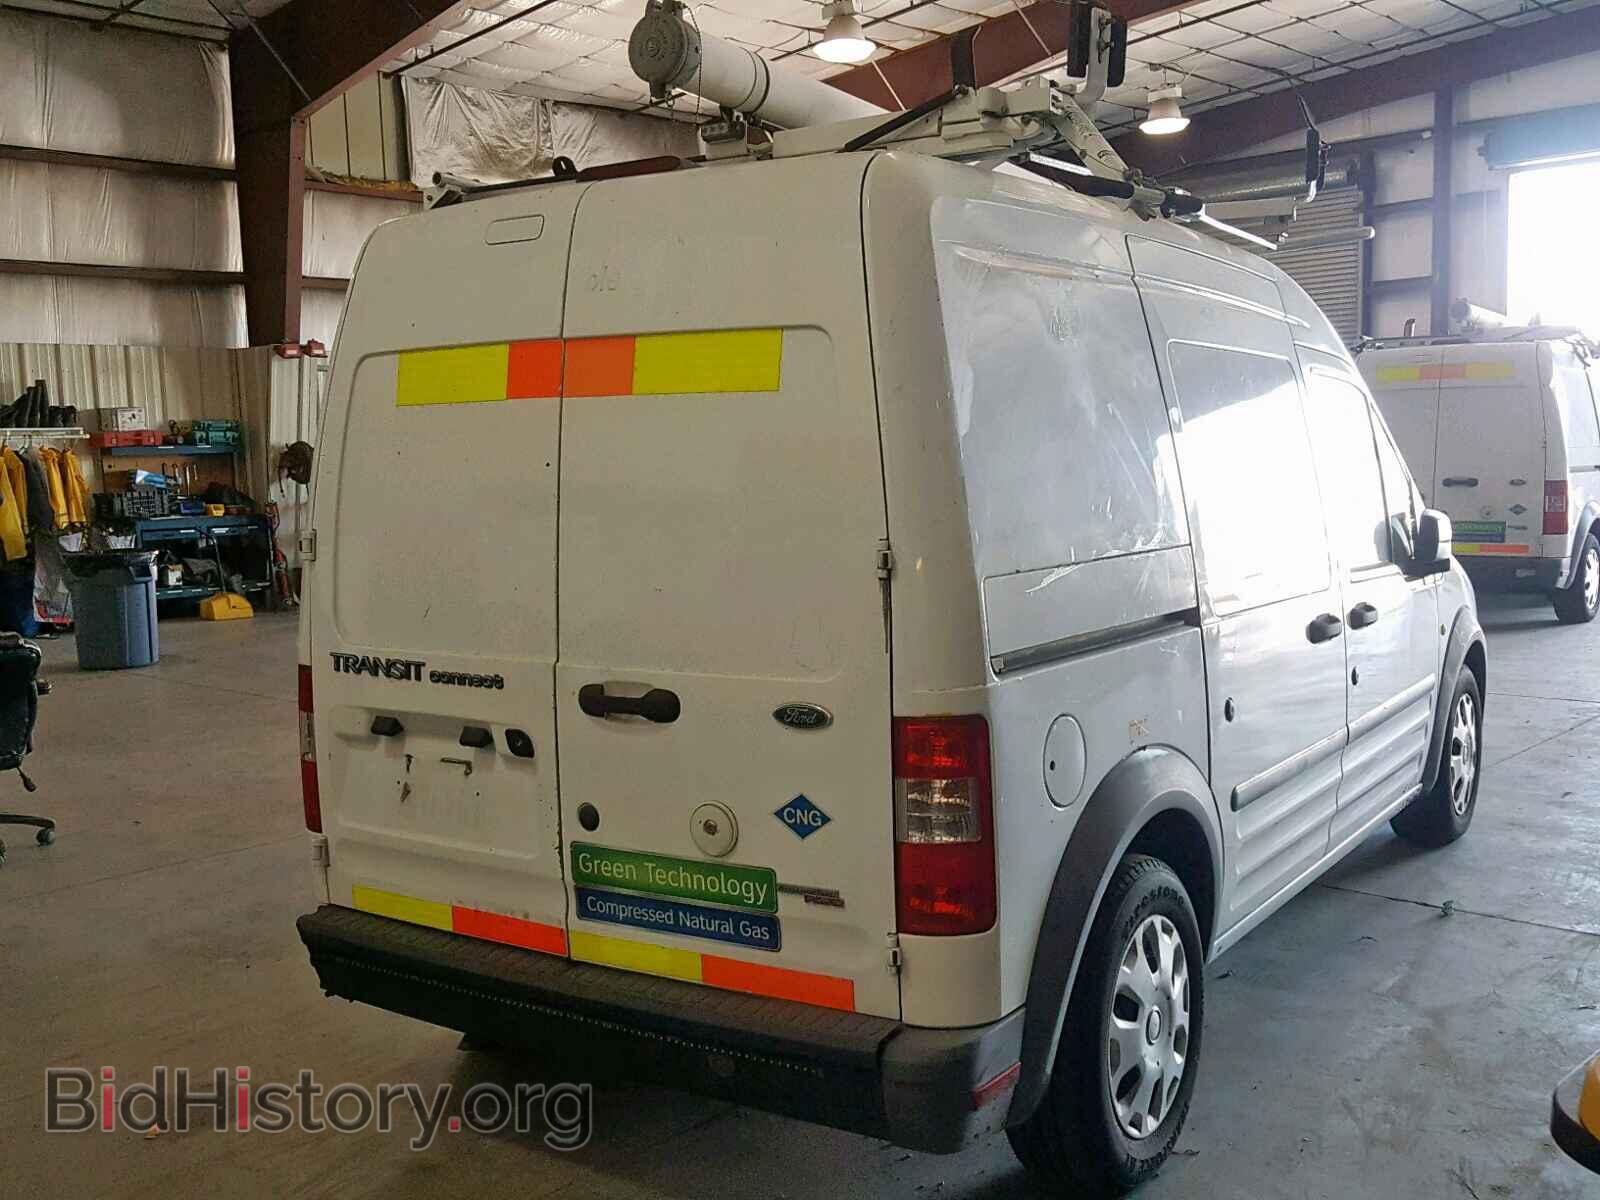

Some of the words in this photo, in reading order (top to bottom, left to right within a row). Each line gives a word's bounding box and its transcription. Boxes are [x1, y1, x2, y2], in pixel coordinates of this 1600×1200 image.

[330, 652, 425, 682] TRANSIT
[429, 670, 504, 689] connect
[784, 706, 817, 724] Ford
[783, 807, 821, 826] CNG
[579, 852, 637, 881] Green
[644, 862, 768, 905] Technology
[586, 896, 674, 925] Compressed
[679, 911, 734, 936] Natural
[739, 920, 769, 940] Gas
